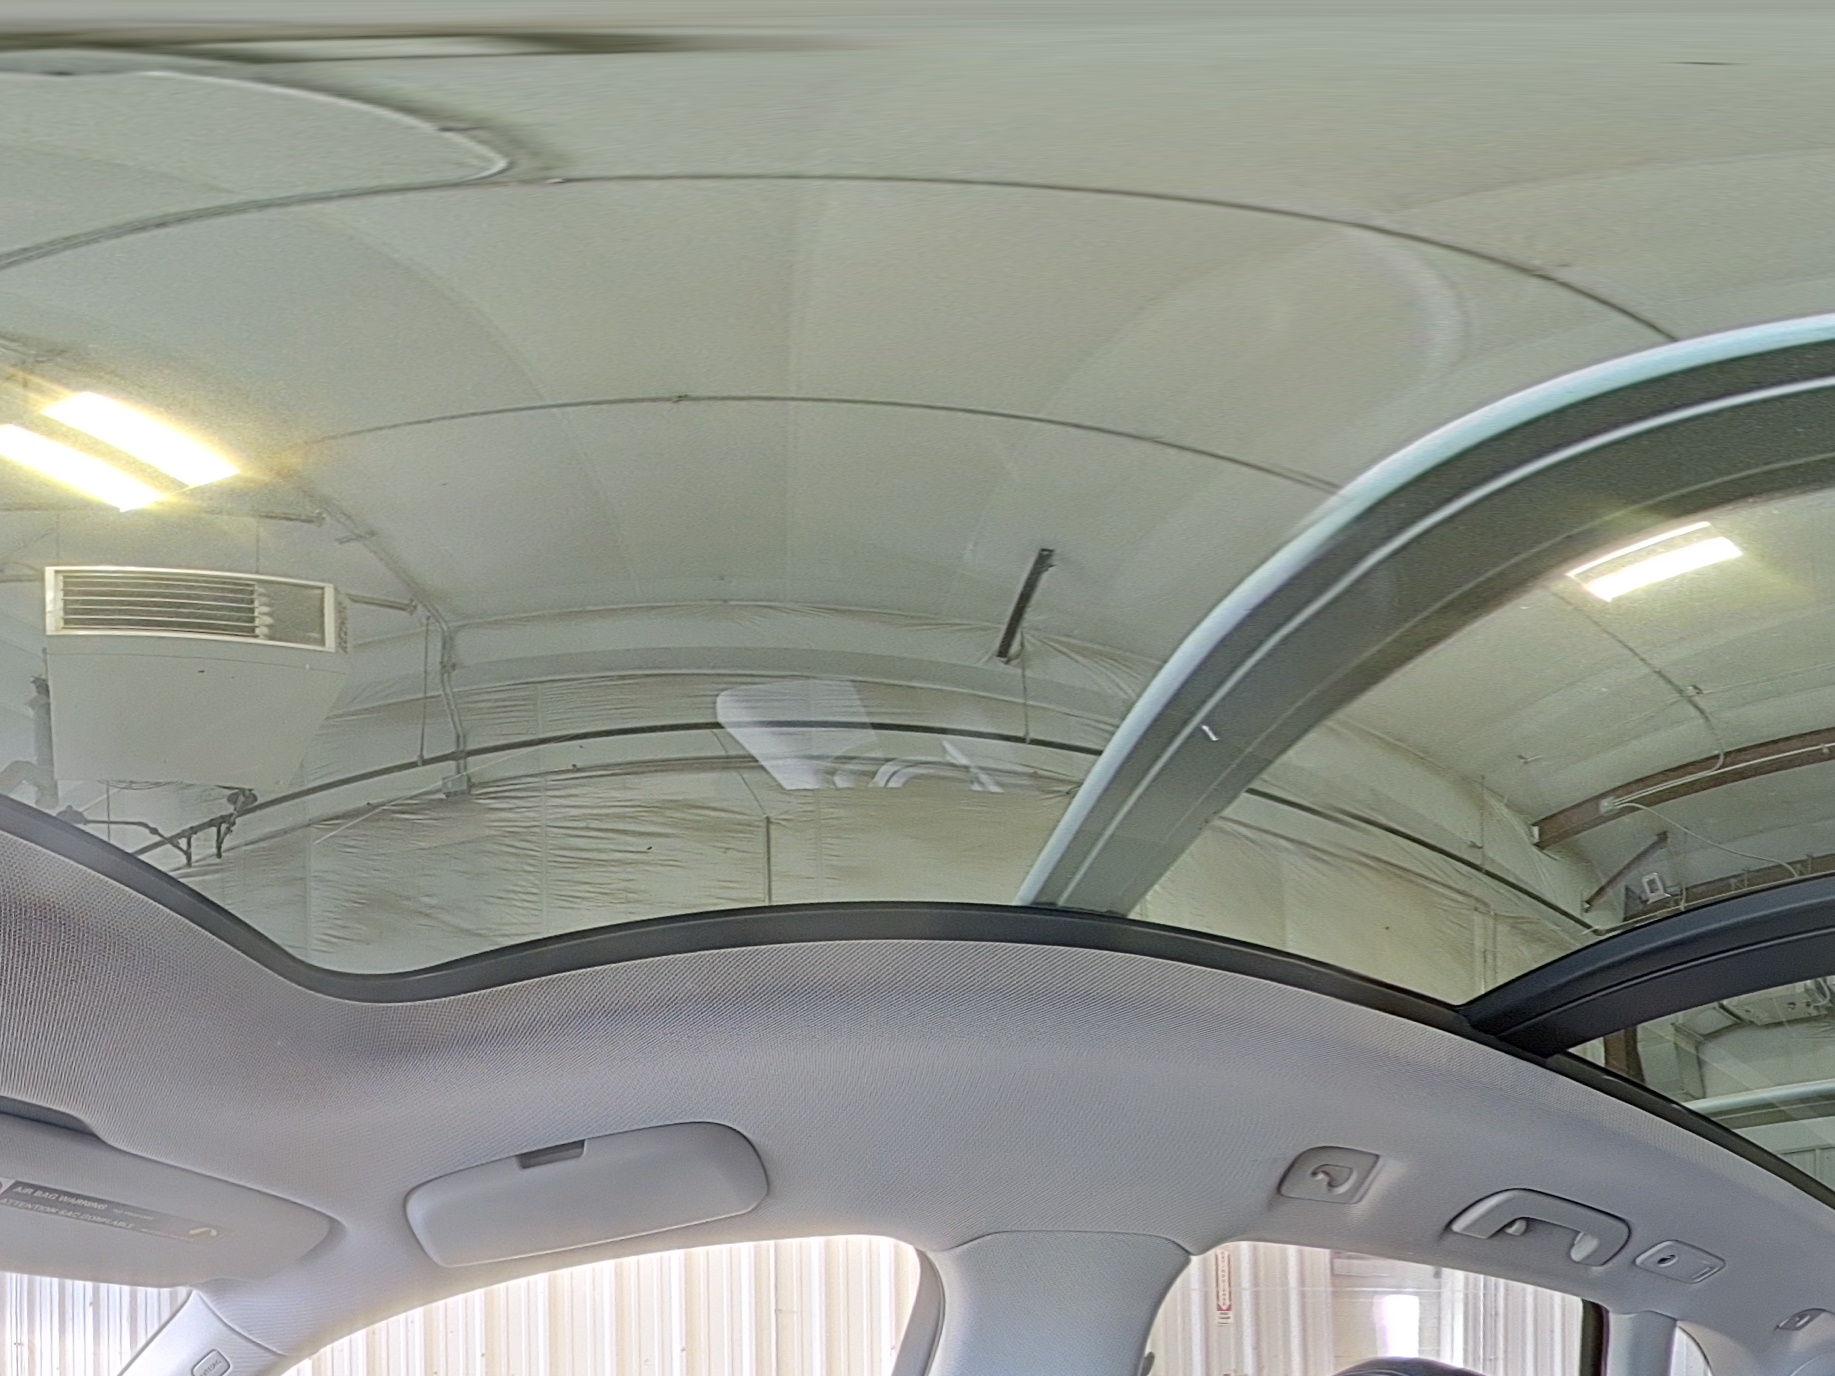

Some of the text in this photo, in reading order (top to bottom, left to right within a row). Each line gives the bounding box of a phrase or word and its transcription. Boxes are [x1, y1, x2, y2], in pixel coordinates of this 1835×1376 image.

[13, 1186, 108, 1210] AIR BAG WARNING
